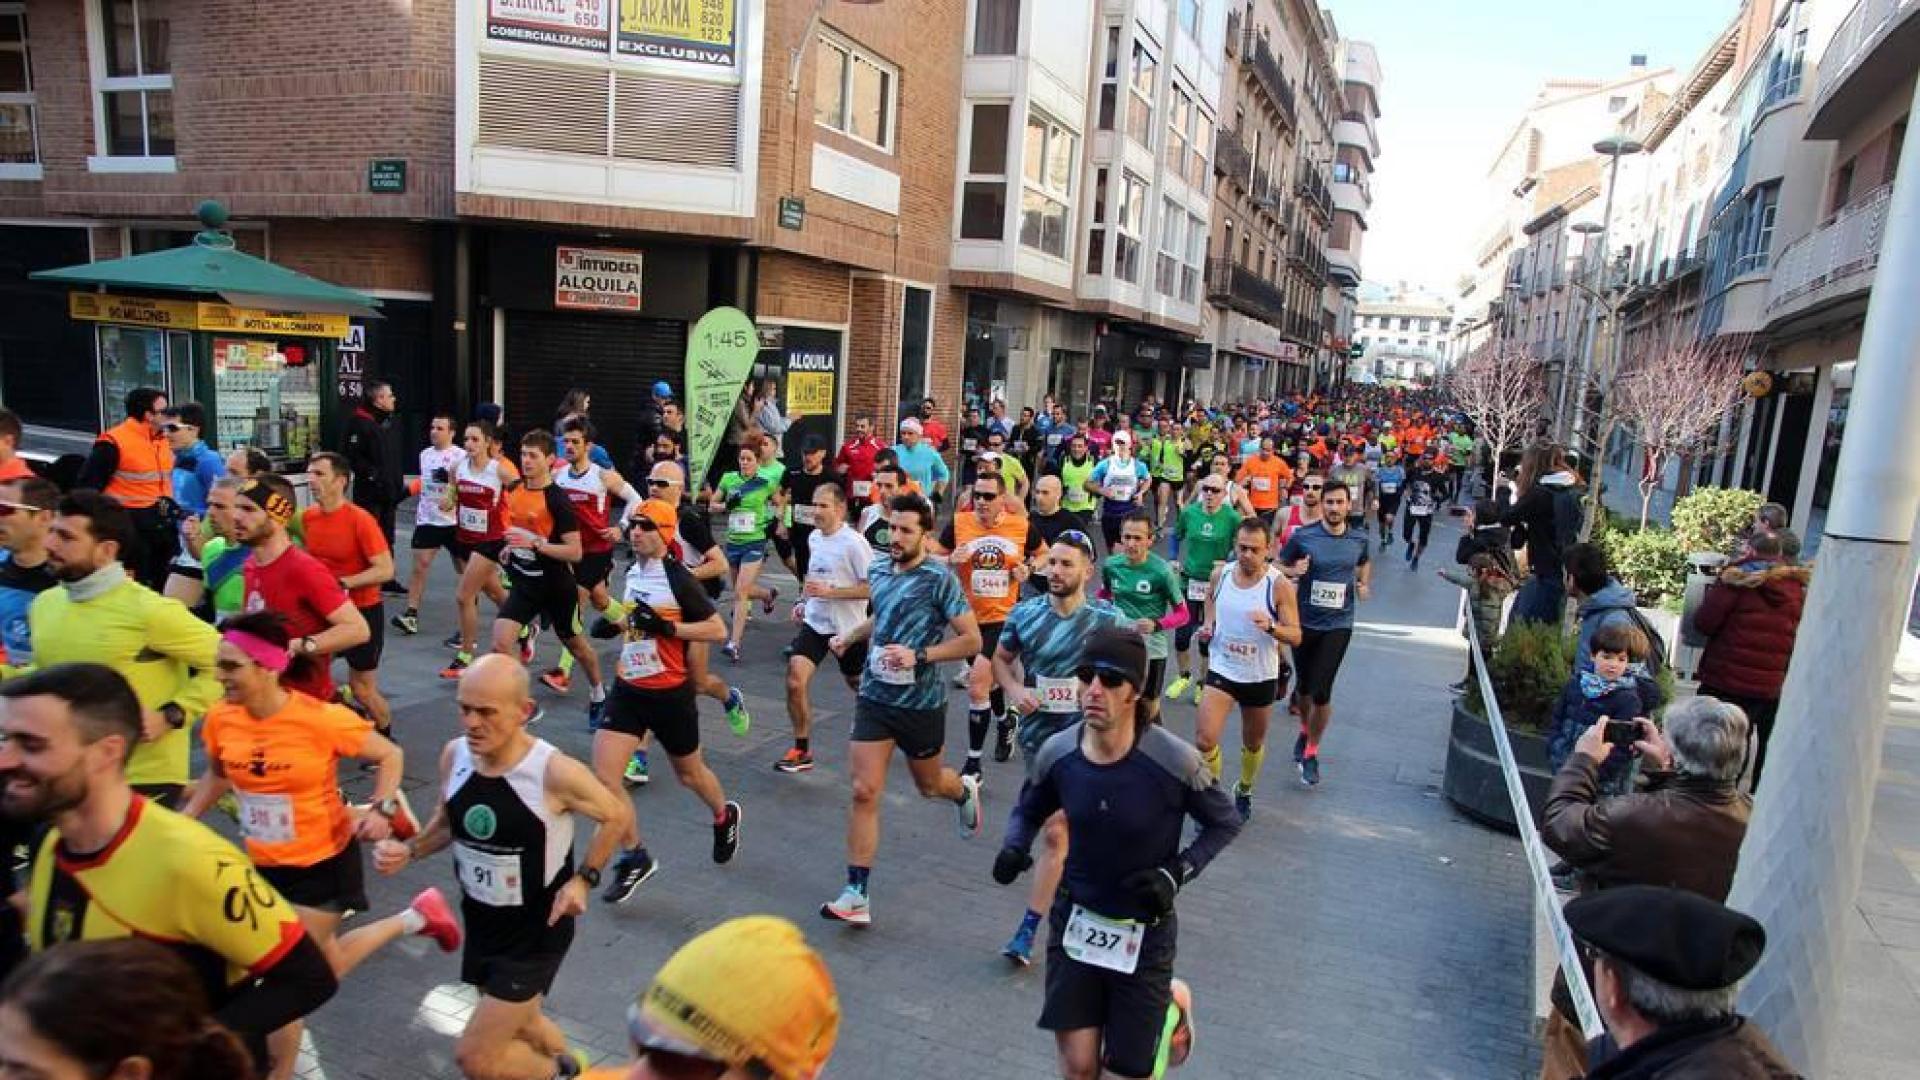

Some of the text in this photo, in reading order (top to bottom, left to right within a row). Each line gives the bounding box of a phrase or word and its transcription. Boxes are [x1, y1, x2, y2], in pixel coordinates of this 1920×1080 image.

[575, 11, 598, 27] 650
[618, 40, 731, 64] EXCLUSIVA
[560, 275, 638, 293] ALQUILA
[704, 331, 748, 350] 1:45
[789, 353, 834, 370] ALQUILA
[474, 866, 492, 887] 91
[1085, 928, 1121, 951] 237
